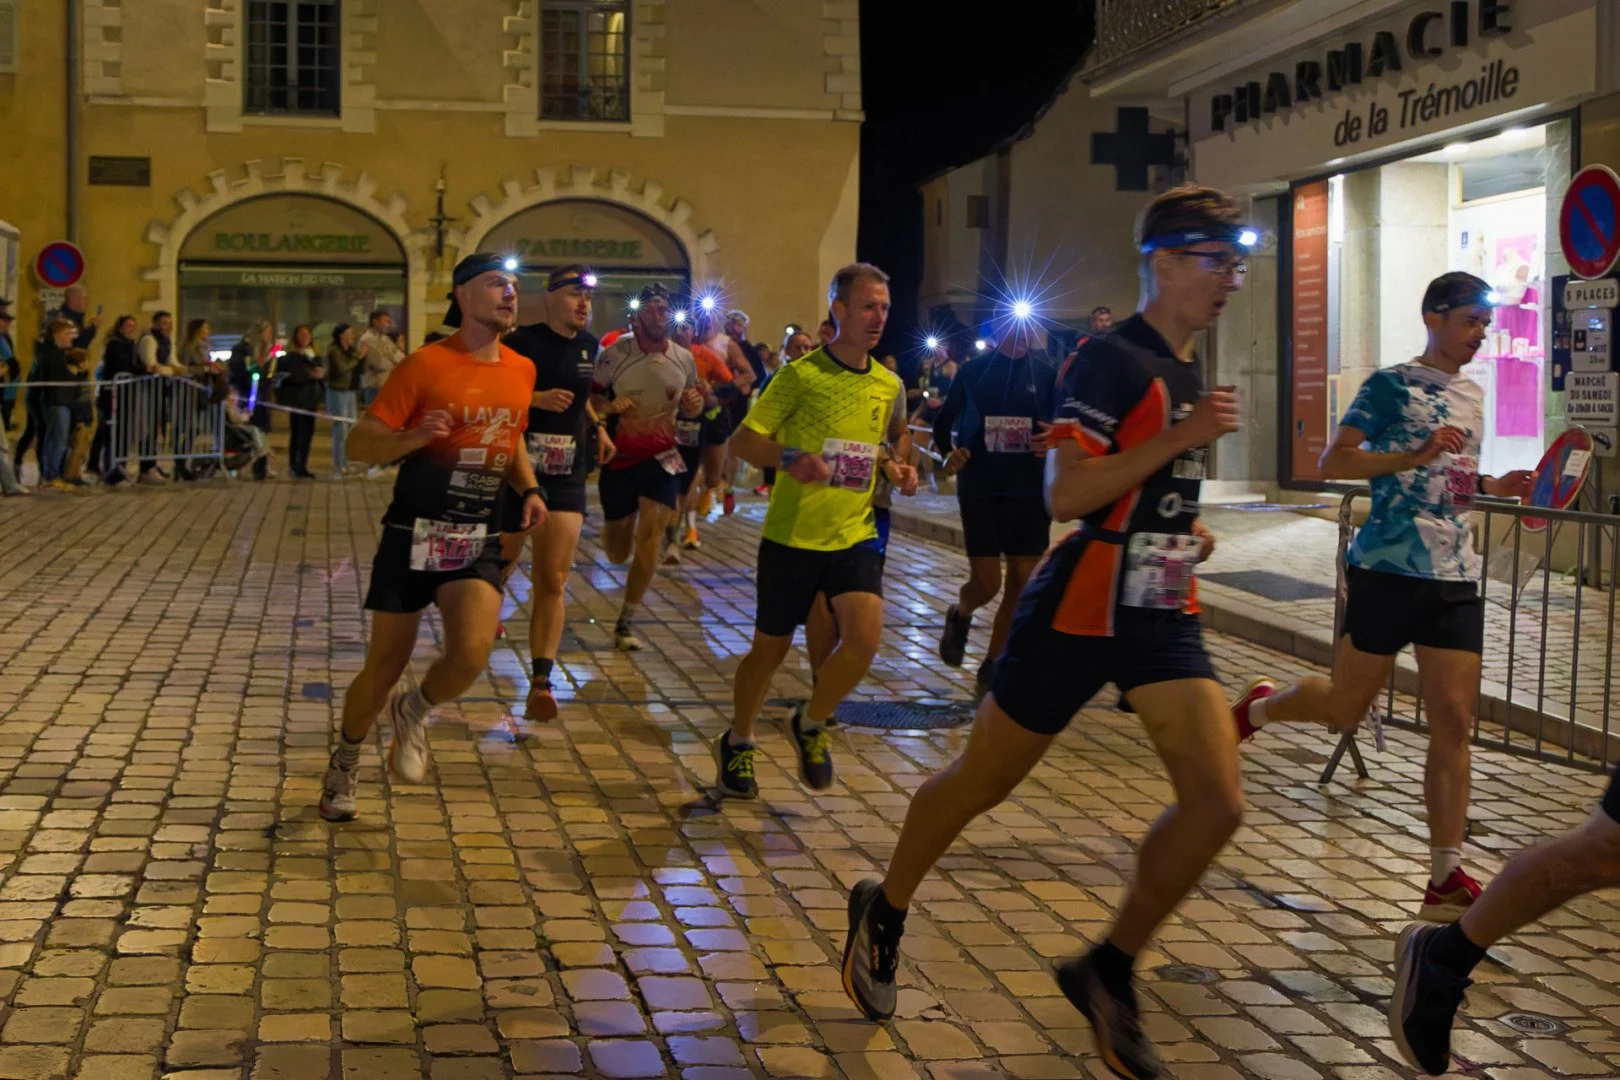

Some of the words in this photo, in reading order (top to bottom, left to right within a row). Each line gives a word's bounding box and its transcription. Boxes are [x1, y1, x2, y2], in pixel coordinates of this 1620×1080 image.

[1211, 0, 1512, 131] PHARMACIE
[1334, 117, 1361, 147] de
[1368, 103, 1388, 139] la
[1398, 60, 1519, 128] Trémoille
[215, 233, 370, 252] BOULANGERIE
[1577, 287, 1615, 301] PLACES
